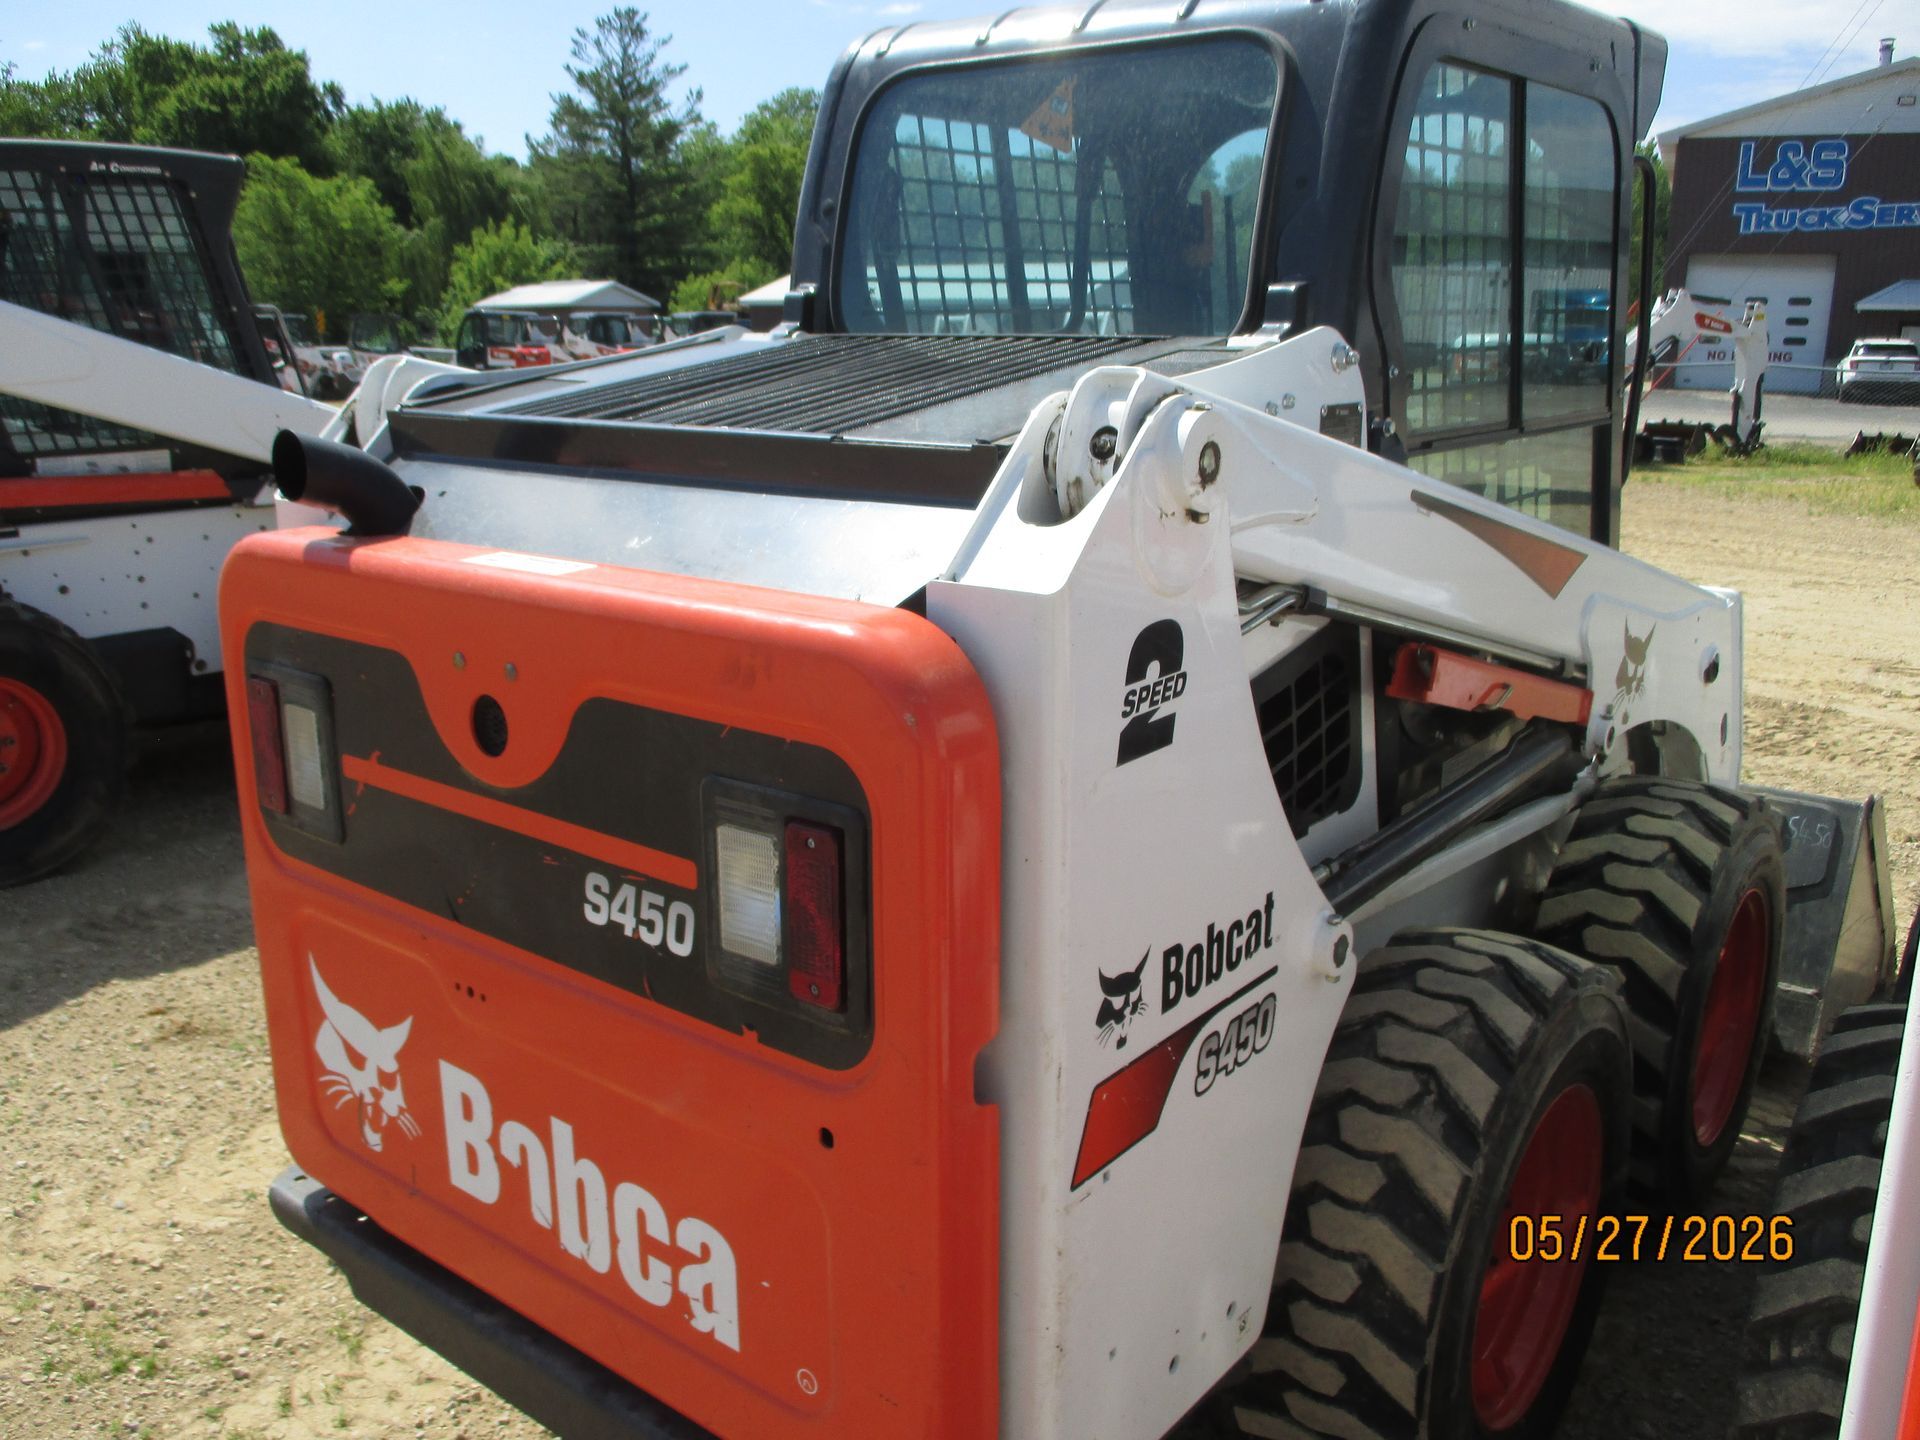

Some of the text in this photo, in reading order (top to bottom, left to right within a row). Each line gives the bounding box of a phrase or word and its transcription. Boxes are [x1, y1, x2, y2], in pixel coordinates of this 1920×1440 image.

[1736, 140, 1849, 192] L&S
[1733, 203, 1846, 234] TRUCK
[1707, 350, 1726, 361] NO
[1116, 618, 1184, 768] 2
[1121, 671, 1188, 719] SPEED
[583, 871, 695, 957] S450
[1161, 891, 1275, 1015] Bobcat
[1194, 992, 1277, 1098] S450
